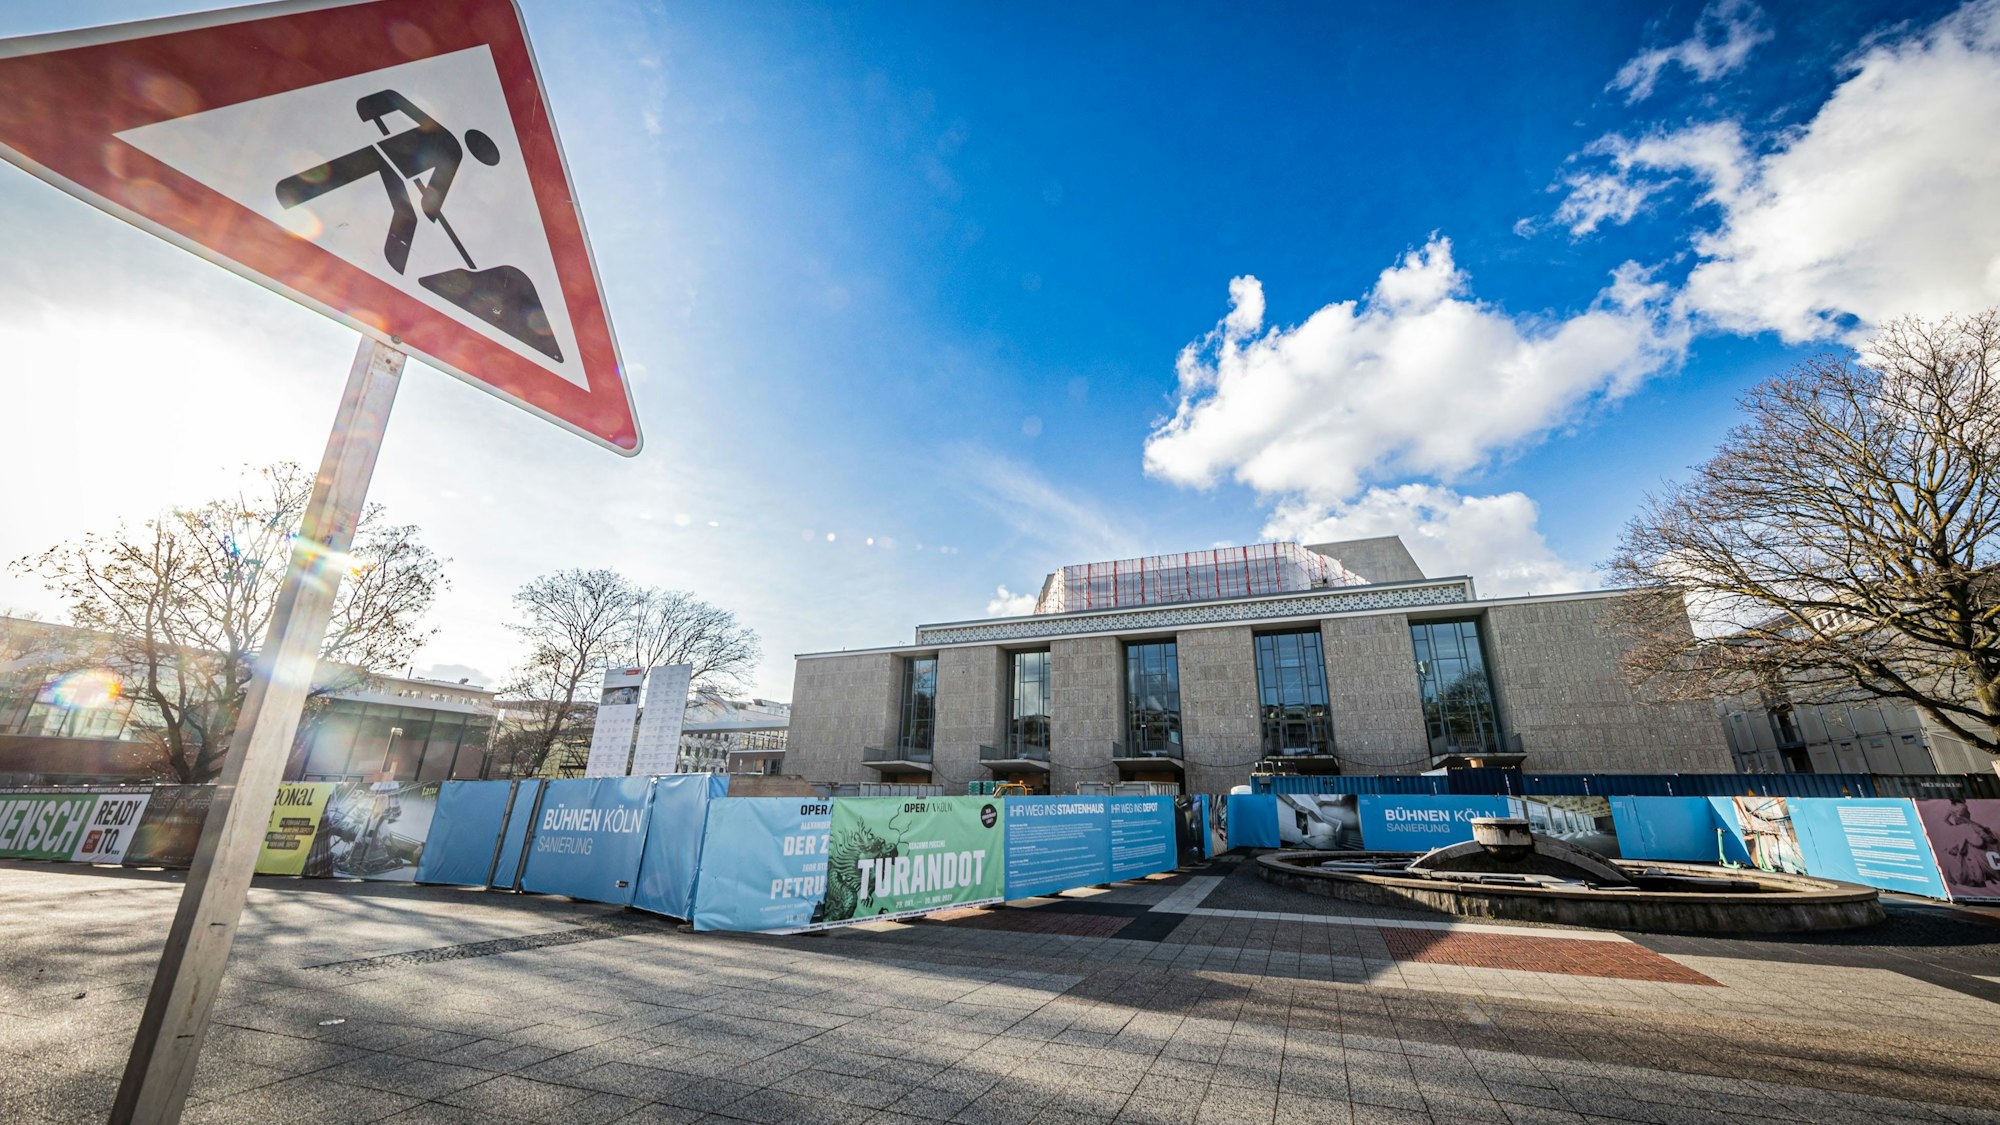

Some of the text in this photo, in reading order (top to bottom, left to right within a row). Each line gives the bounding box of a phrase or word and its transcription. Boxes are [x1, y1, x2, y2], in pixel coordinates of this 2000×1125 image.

[94, 801, 142, 825] READY
[543, 803, 644, 833] BÜHNEN KÖLN
[1009, 805, 1025, 817] IHR
[1025, 804, 1044, 816] WEG
[1044, 804, 1057, 816] INS
[1057, 803, 1105, 815] STAATENHAUS
[1111, 802, 1158, 814] IHR WEG INS DEPOT
[1384, 806, 1450, 822] BÜHNEN
[1386, 823, 1450, 833] SANIERUNG
[98, 829, 119, 855] TO...
[537, 836, 593, 855] SANIERUNG
[783, 835, 816, 856] DER
[857, 850, 985, 900] TURANDOT
